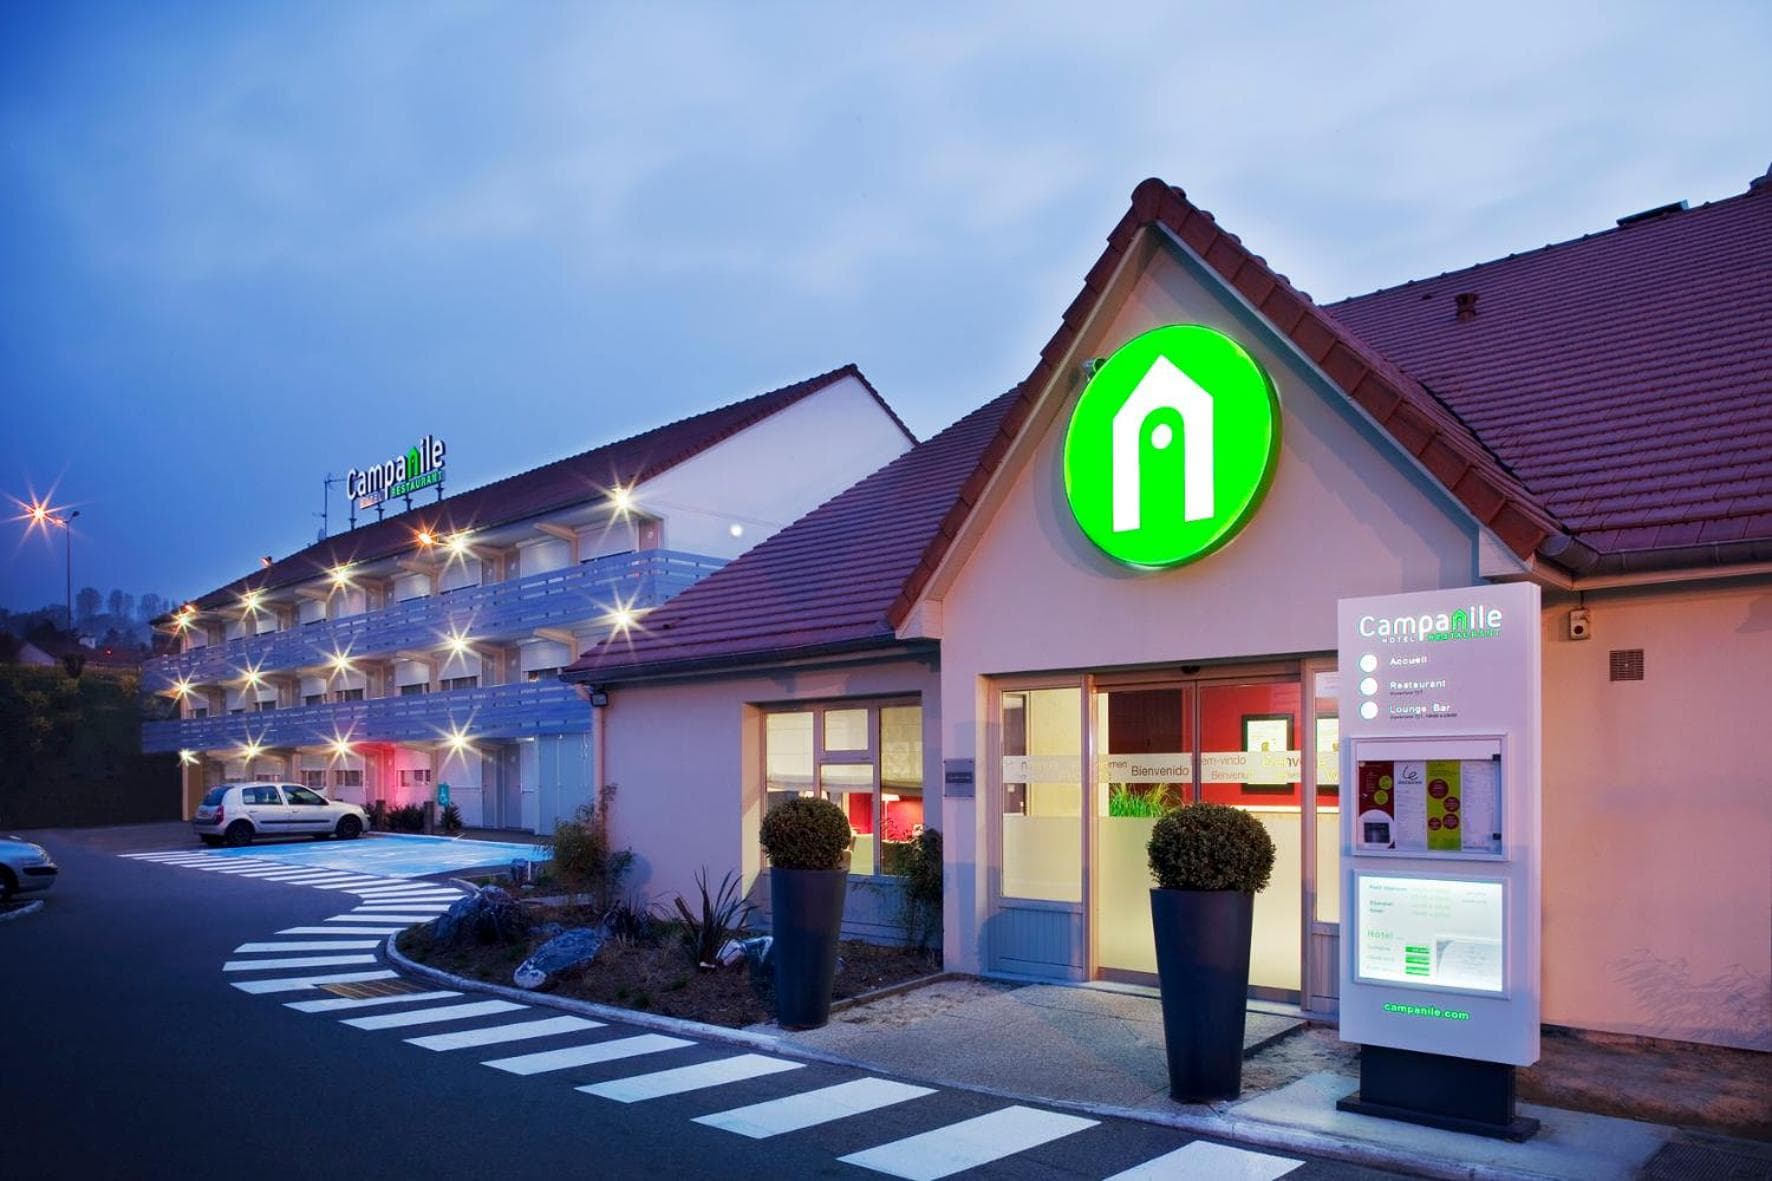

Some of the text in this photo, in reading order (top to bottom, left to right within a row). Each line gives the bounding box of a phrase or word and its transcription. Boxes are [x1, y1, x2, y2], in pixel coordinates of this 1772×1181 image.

[347, 434, 446, 501] Campanile
[1359, 605, 1503, 641] Campanile
[1382, 635, 1416, 644] HOTEL
[1389, 655, 1428, 666] Accueil
[1389, 679, 1447, 690] Restaurant
[1389, 703, 1451, 714] Lounge Bar
[1131, 765, 1190, 777] Bienvenido
[1384, 1002, 1470, 1020] campanile.com
